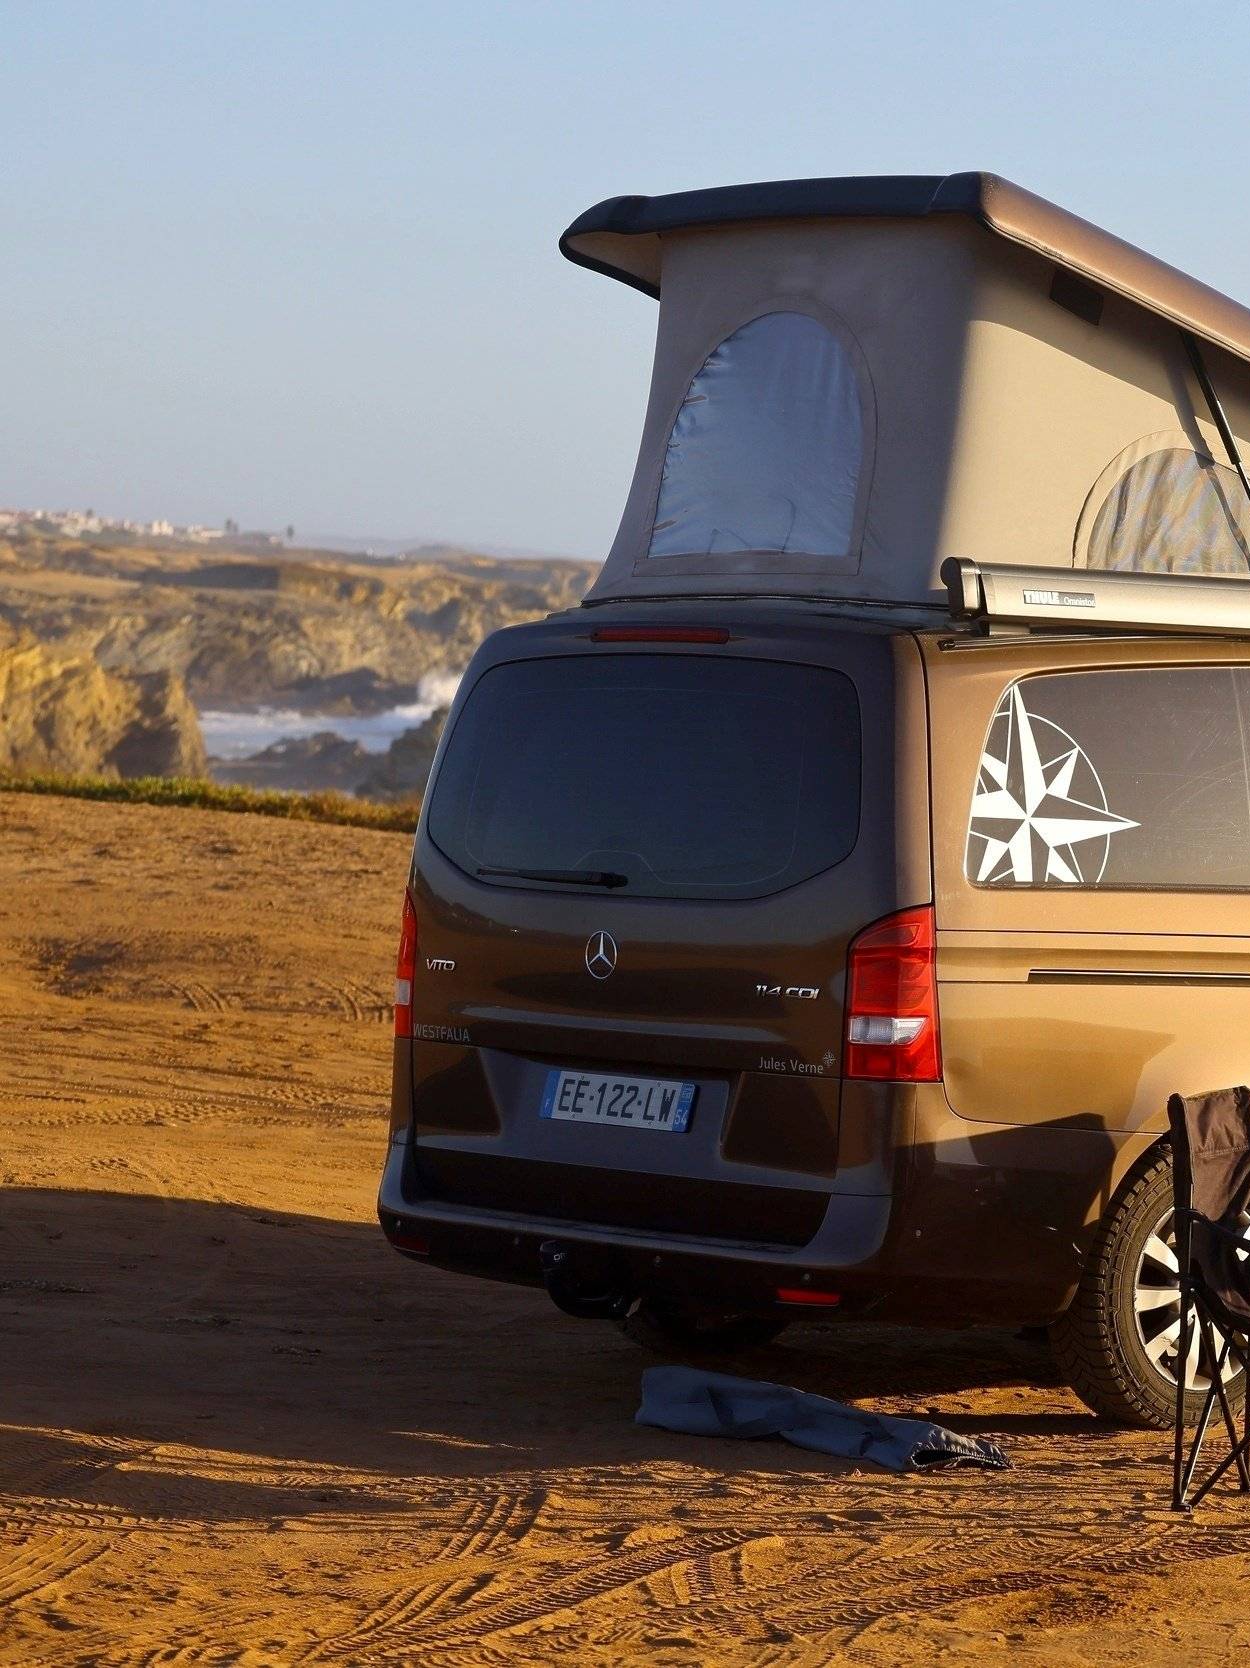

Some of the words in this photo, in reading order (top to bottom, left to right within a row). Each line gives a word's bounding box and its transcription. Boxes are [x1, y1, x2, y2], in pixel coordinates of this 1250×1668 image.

[1024, 591, 1060, 605] THULE
[426, 958, 456, 971] VITO
[755, 984, 782, 998] 114
[785, 986, 820, 1000] CDI
[413, 1023, 470, 1042] WESTFALIA
[758, 1055, 787, 1071] Jules
[789, 1059, 824, 1074] Verne
